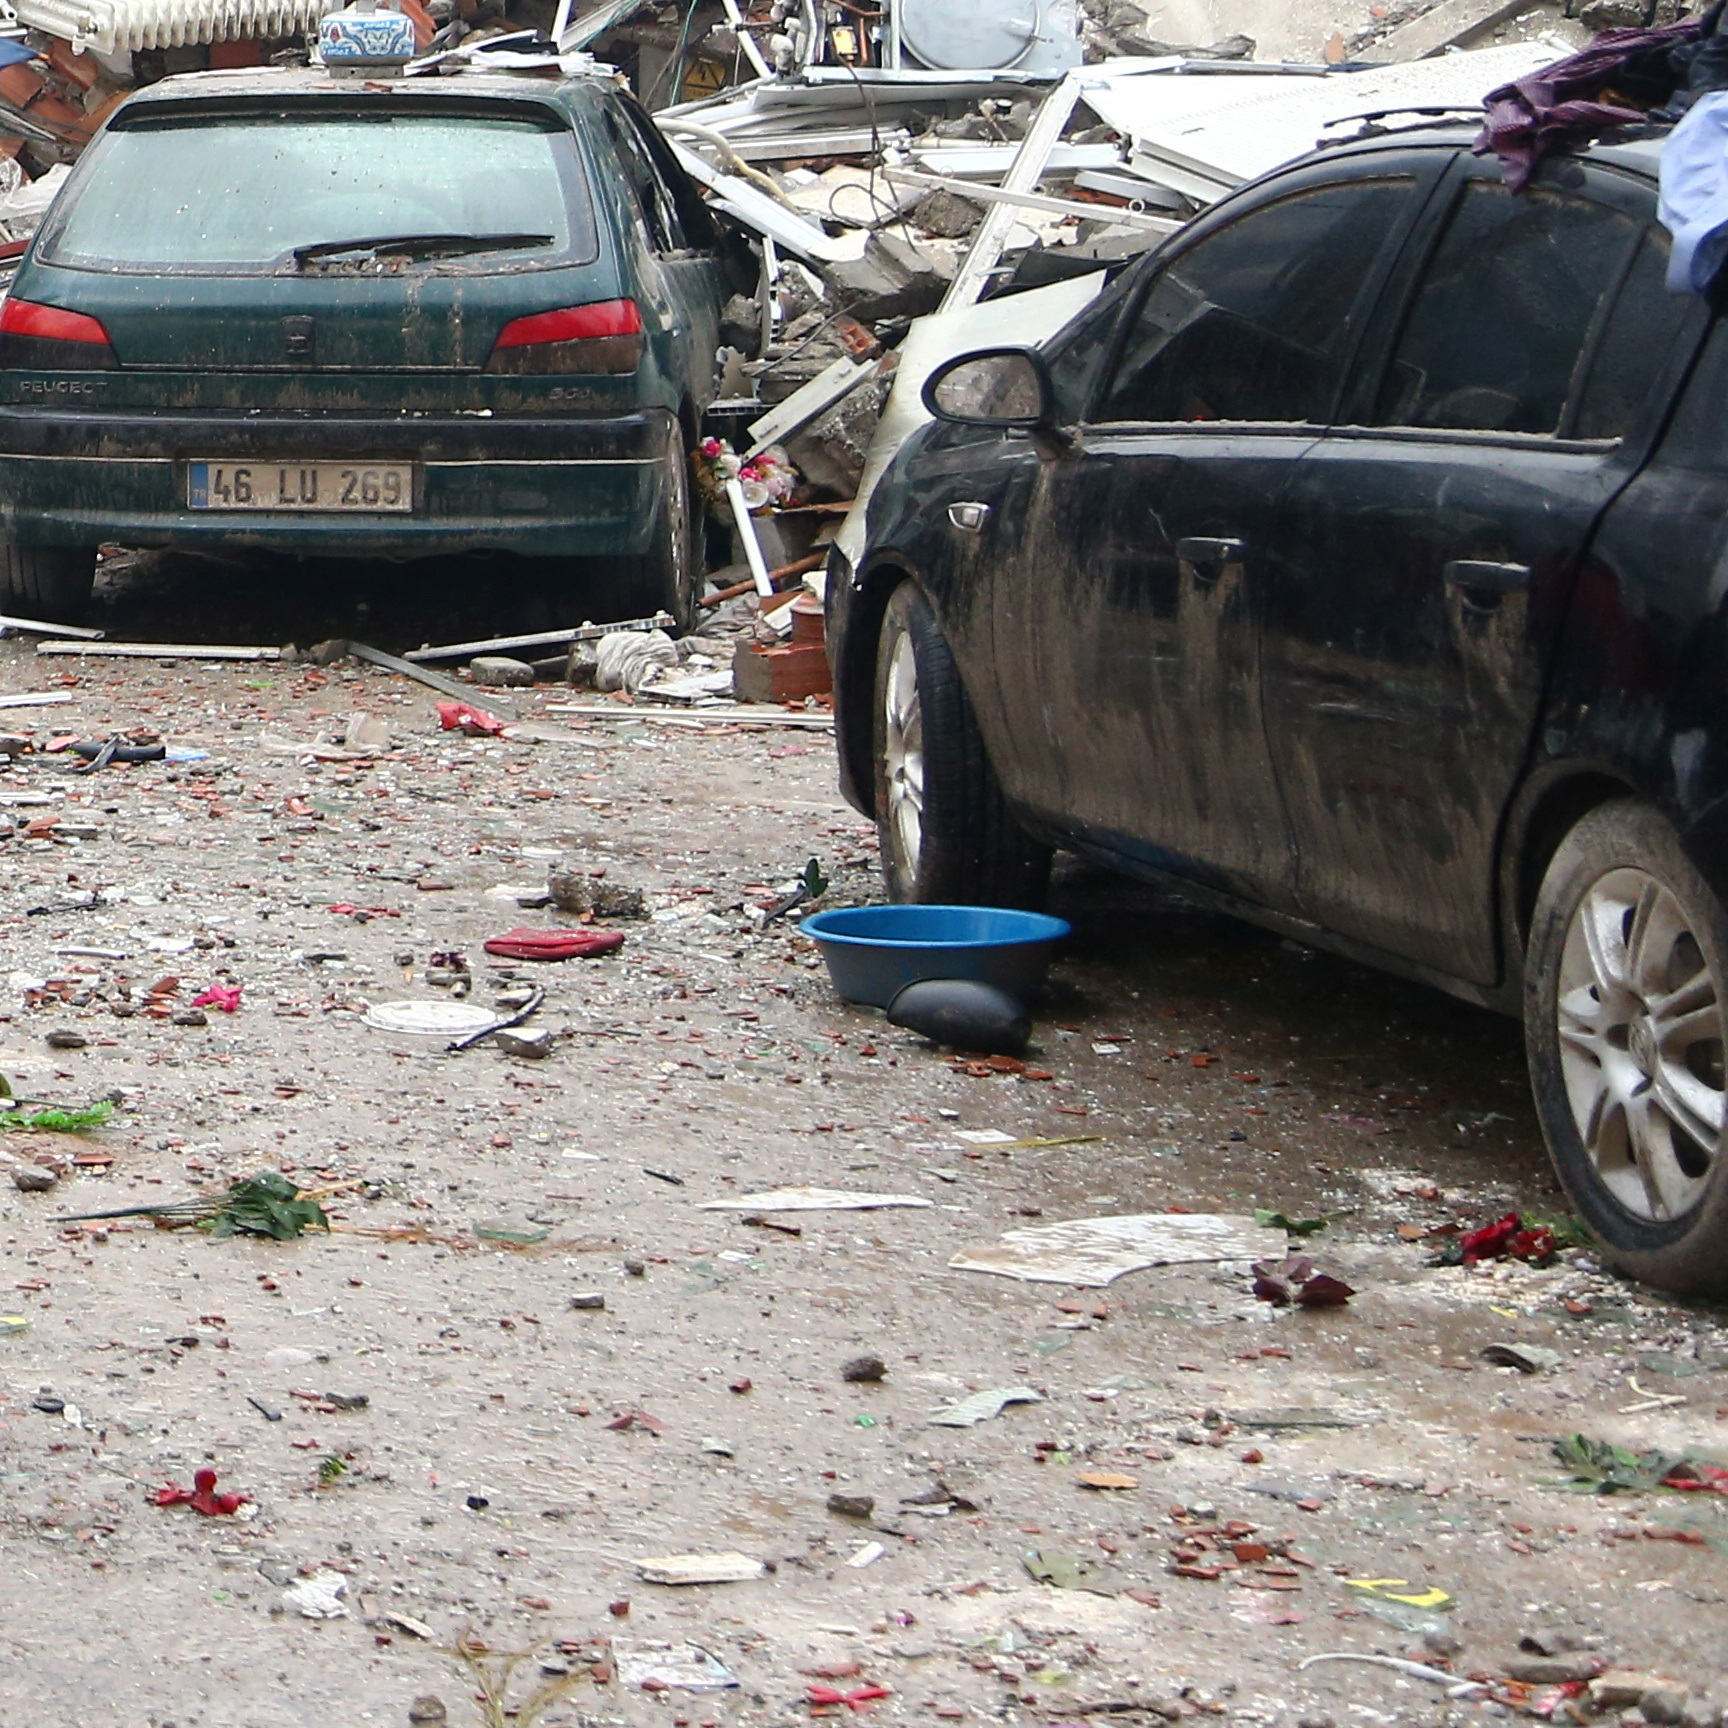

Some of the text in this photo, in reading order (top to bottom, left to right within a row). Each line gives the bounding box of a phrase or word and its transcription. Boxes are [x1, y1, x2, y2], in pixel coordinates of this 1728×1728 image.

[214, 468, 253, 502] 46
[279, 469, 317, 504] LU
[341, 469, 402, 505] 269
